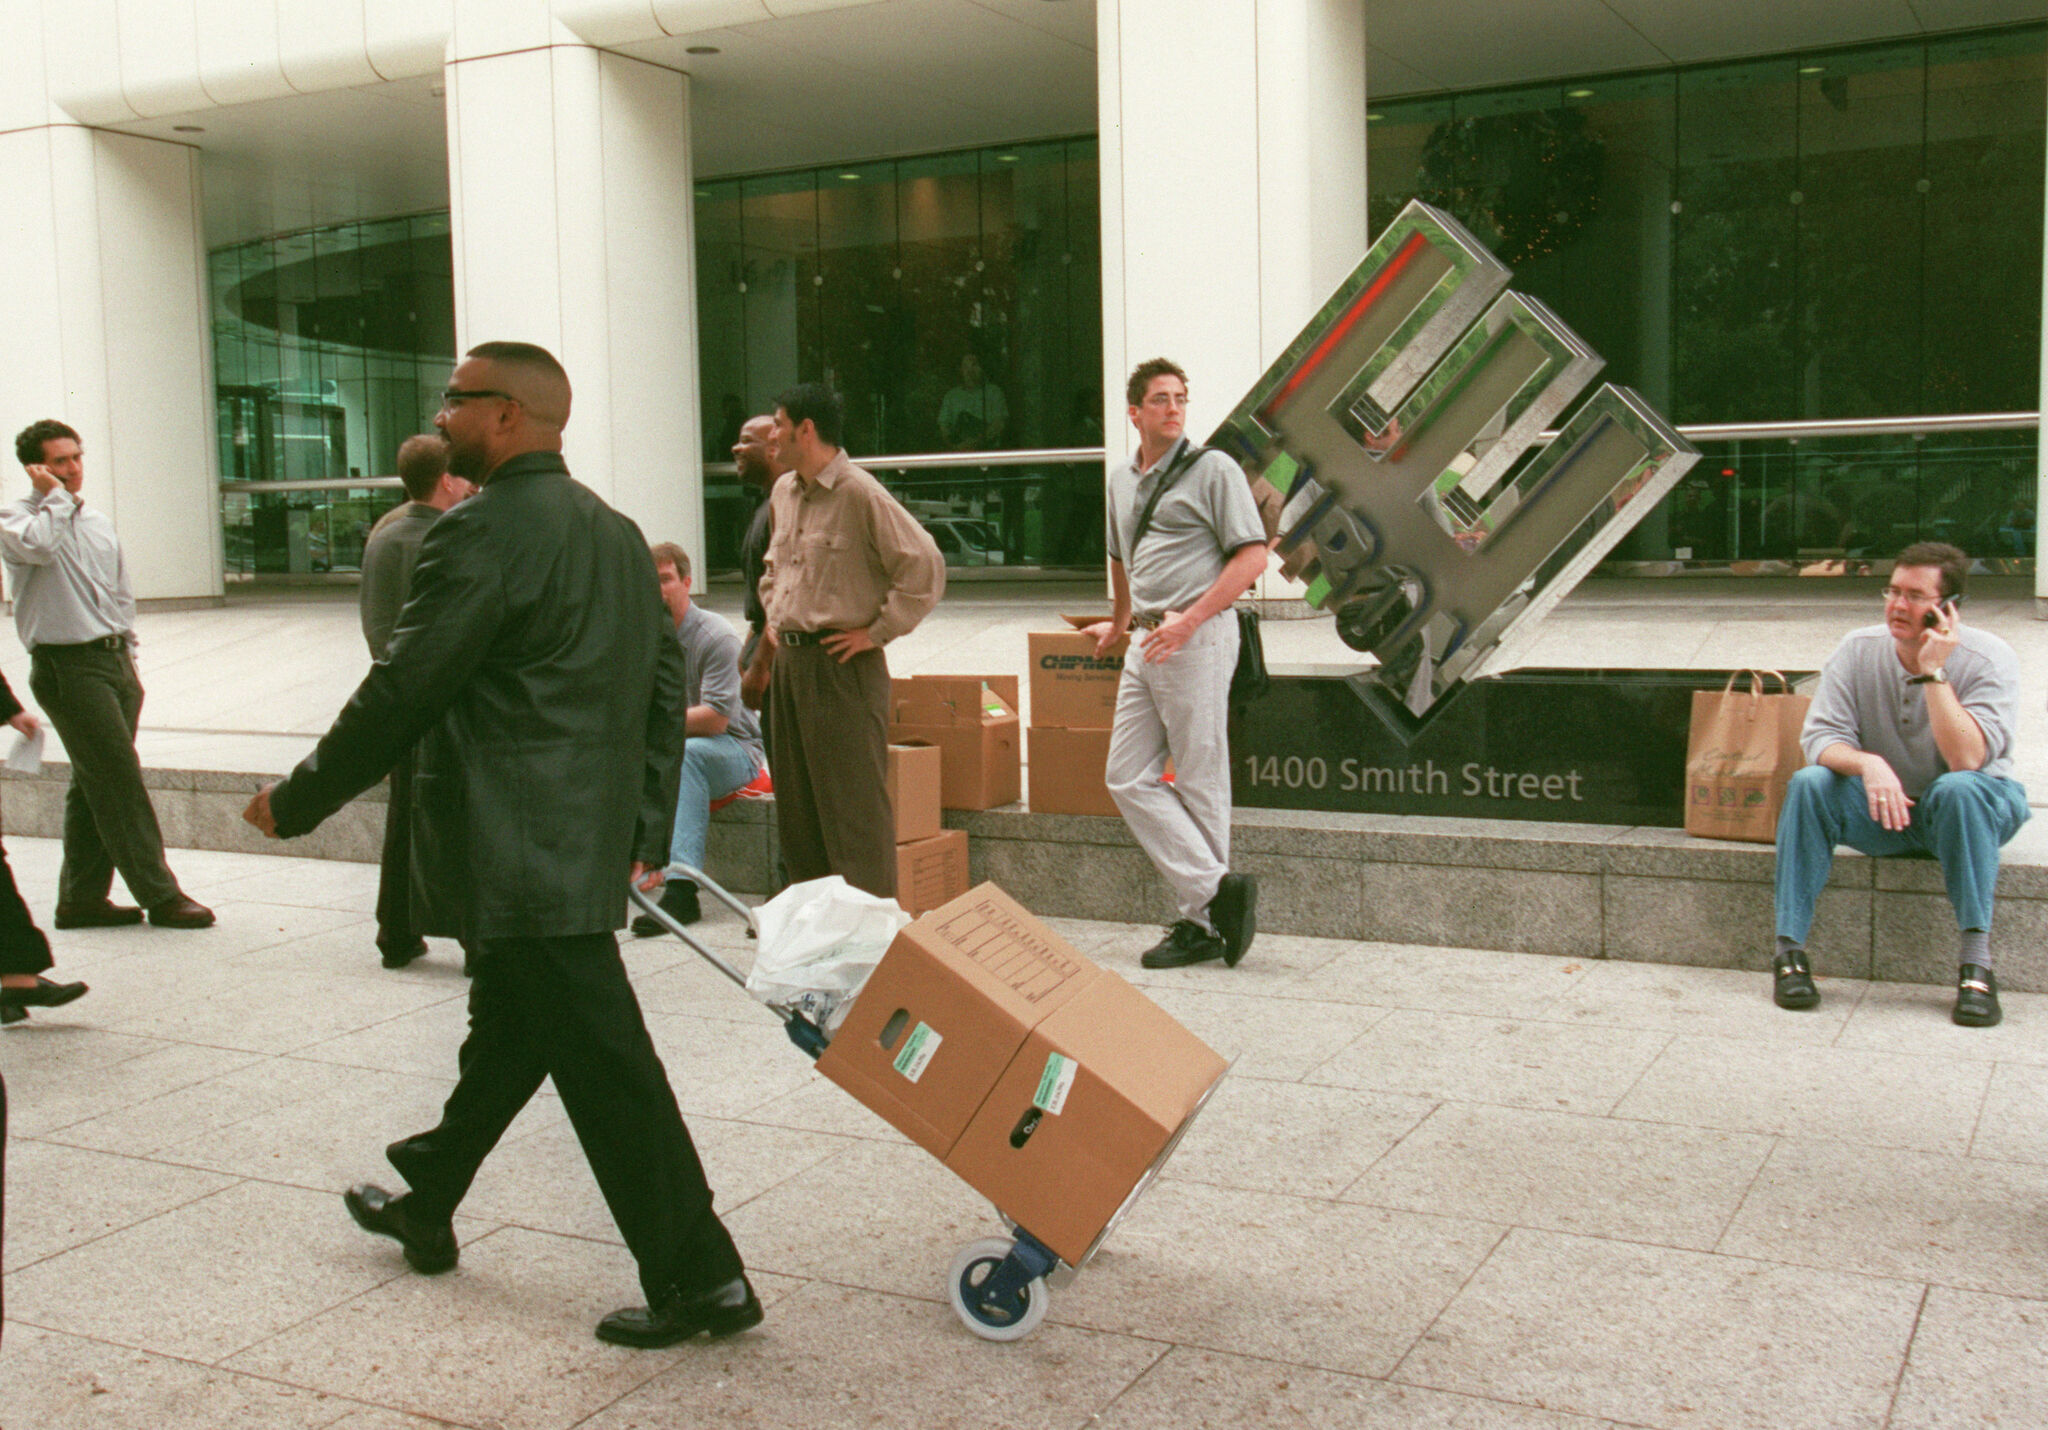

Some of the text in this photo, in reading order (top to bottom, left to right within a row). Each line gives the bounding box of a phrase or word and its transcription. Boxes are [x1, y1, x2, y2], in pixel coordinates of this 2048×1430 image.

[1246, 755, 1583, 801] 1400 Smith Street
